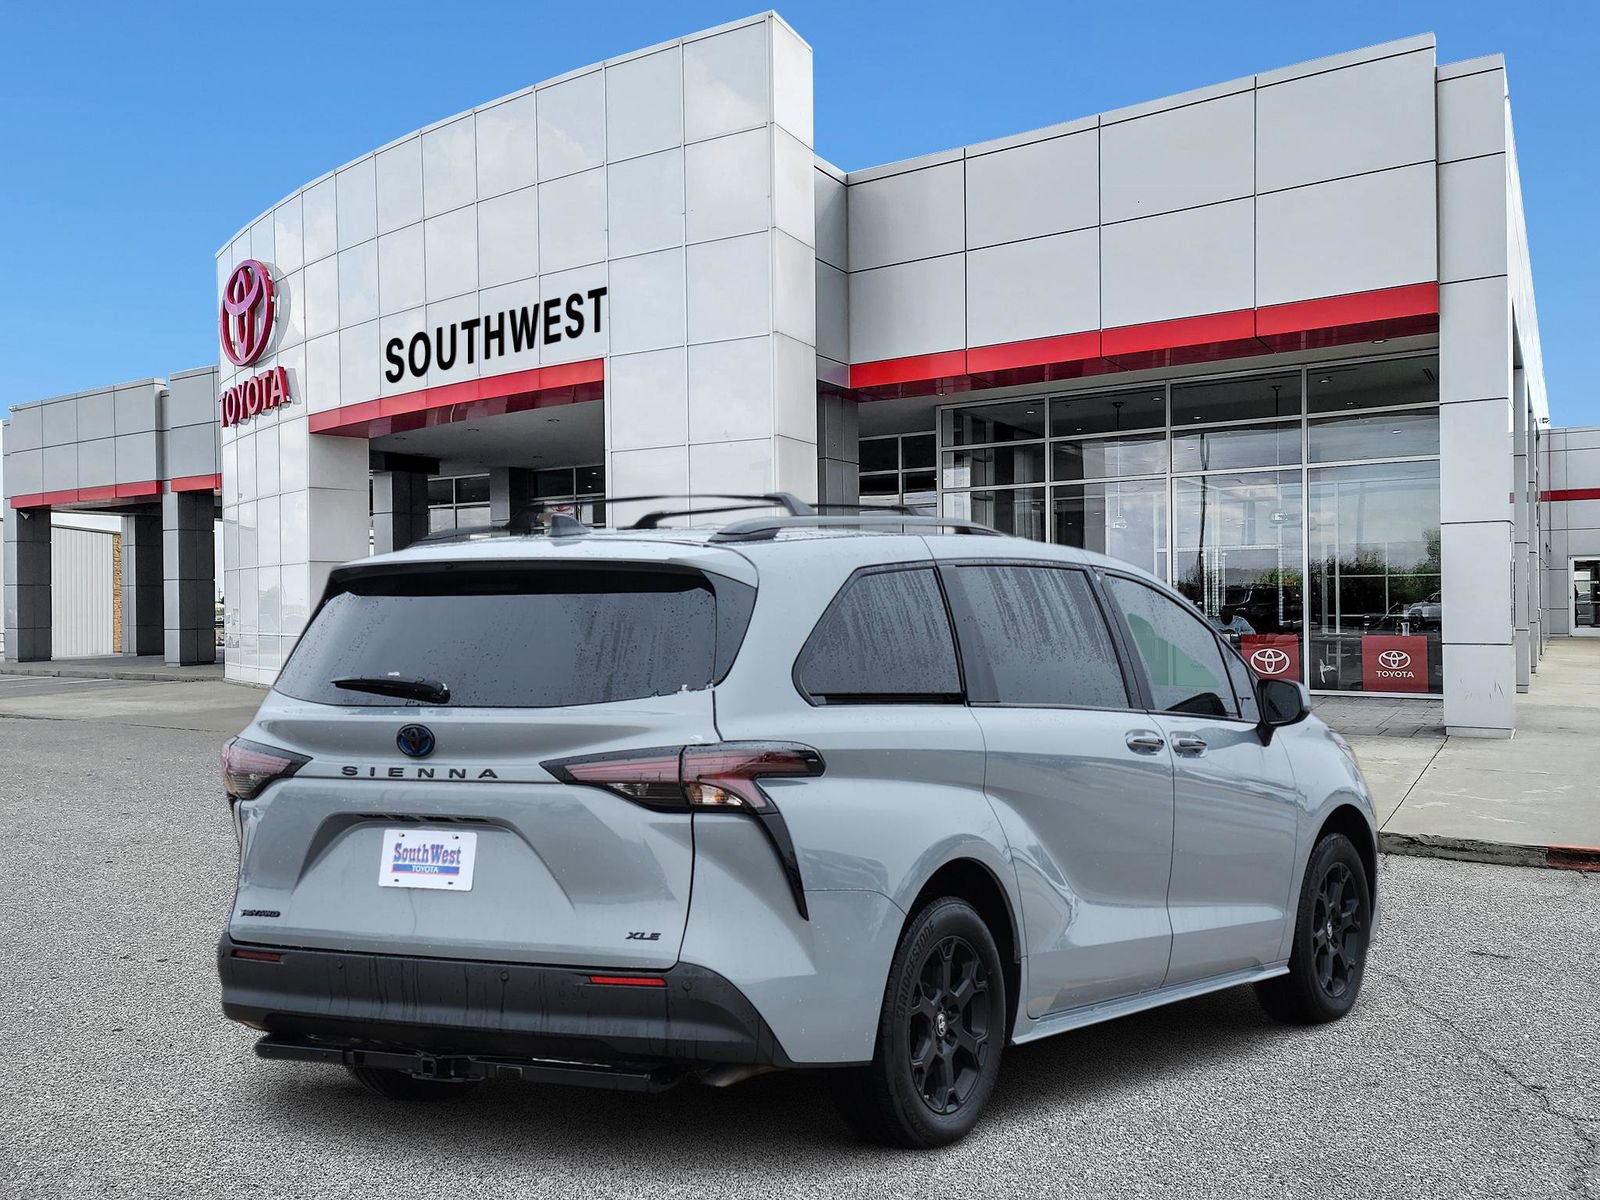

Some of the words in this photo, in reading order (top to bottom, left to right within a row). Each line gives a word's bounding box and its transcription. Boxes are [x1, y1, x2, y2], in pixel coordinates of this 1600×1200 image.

[385, 286, 607, 383] SOUTHWEST
[218, 366, 290, 428] TOYOTA
[1376, 670, 1415, 678] TOYOTA
[341, 765, 499, 779] SIENNA
[411, 864, 439, 873] TOYOTA
[625, 931, 662, 941] XLE
